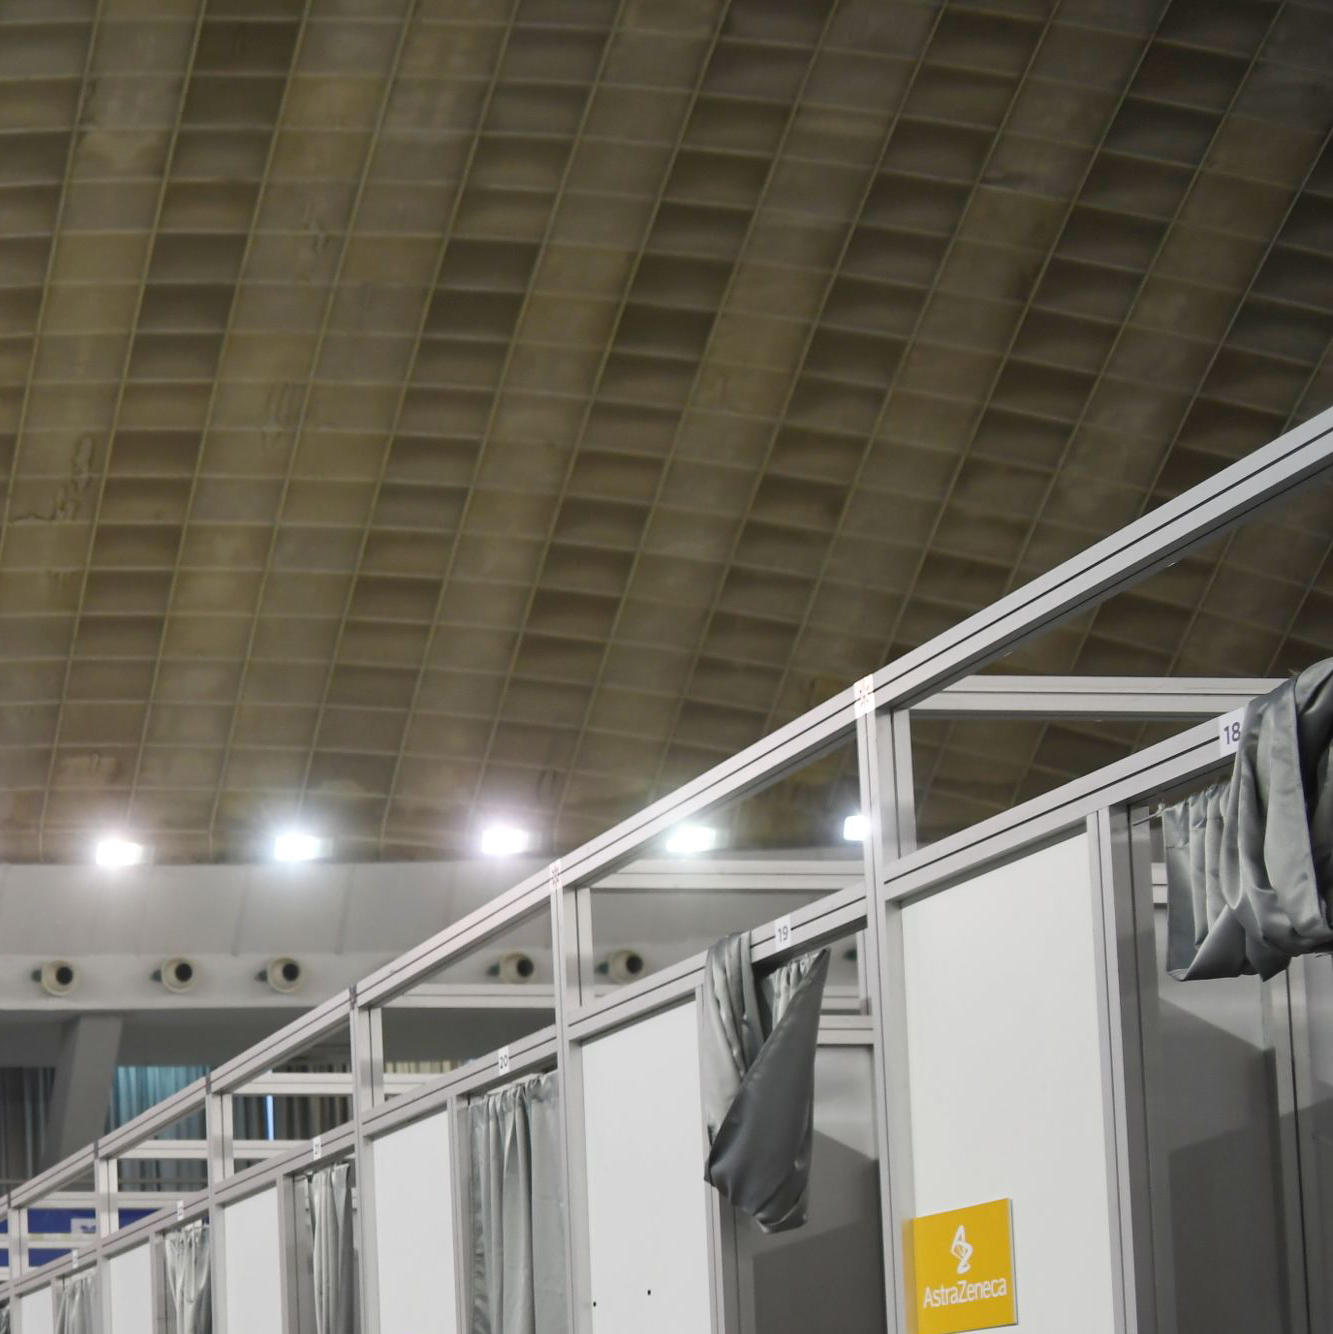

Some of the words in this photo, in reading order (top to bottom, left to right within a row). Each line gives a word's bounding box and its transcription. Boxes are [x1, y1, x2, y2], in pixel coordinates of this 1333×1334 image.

[1223, 721, 1241, 745] 18
[778, 925, 789, 943] 19
[922, 1277, 1008, 1309] AstraZeneca
